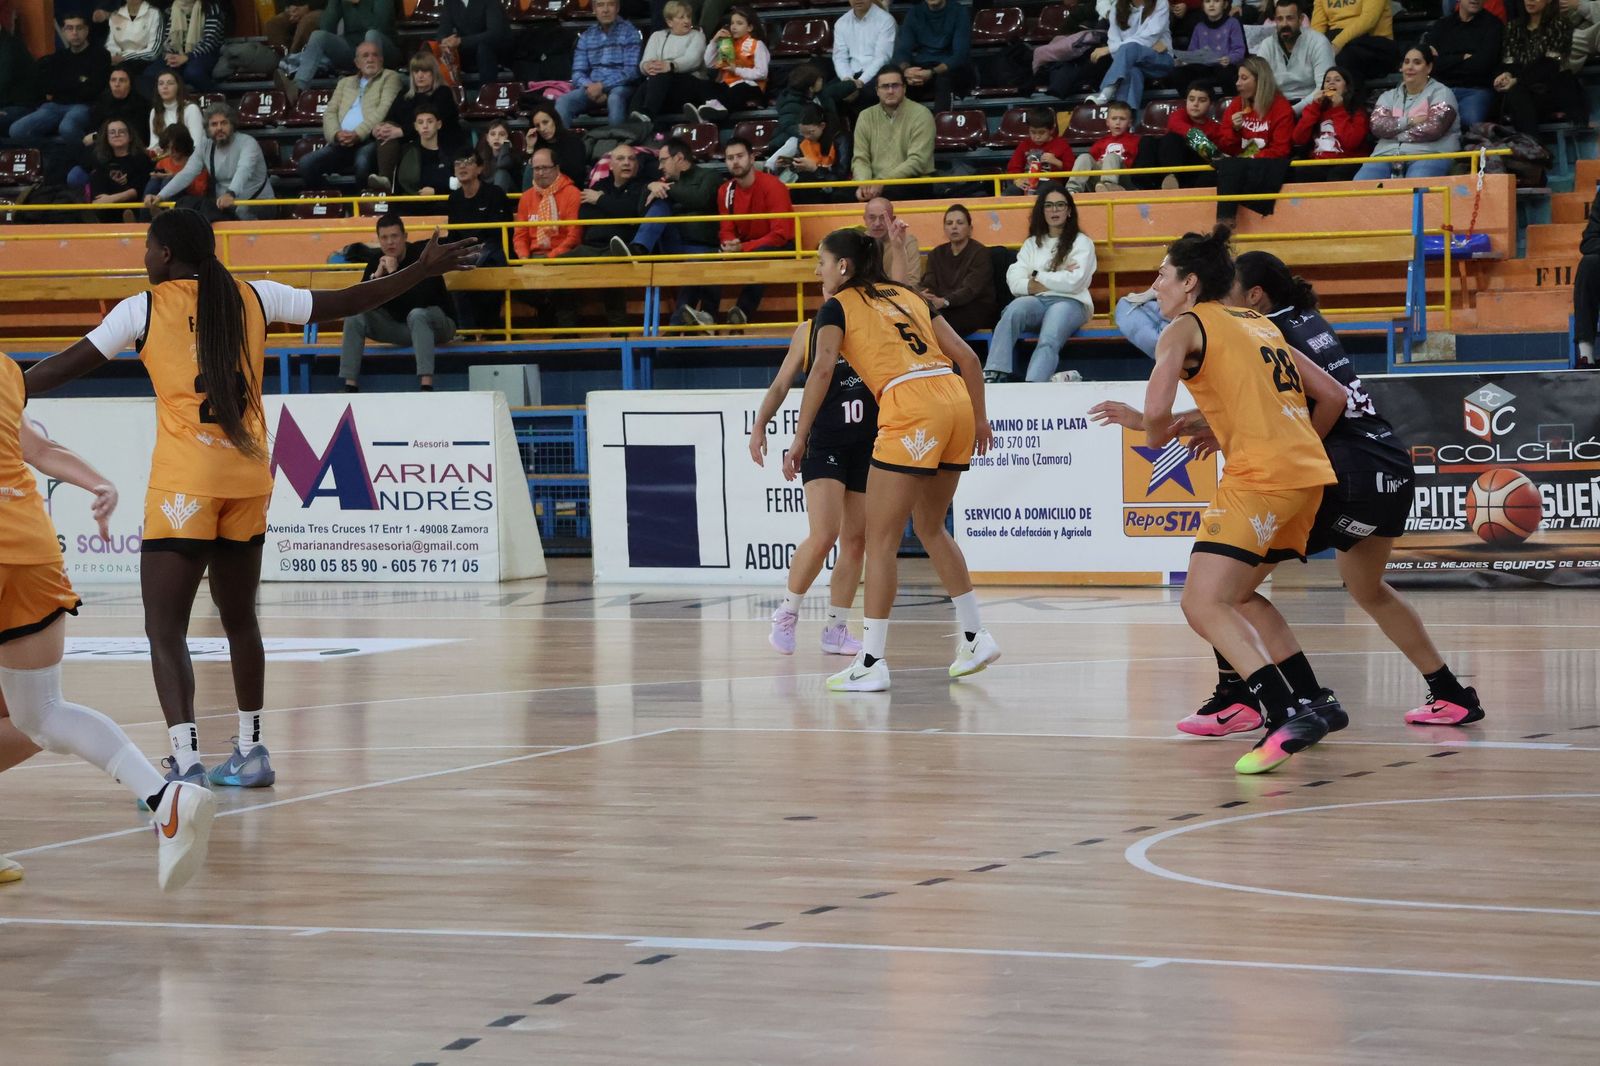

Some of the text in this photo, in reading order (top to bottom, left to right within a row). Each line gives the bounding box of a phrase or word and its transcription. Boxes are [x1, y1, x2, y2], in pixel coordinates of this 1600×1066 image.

[995, 13, 1004, 26] 7
[804, 23, 811, 35] 1
[498, 86, 507, 98] 8
[956, 114, 966, 127] 9
[690, 129, 697, 141] 1
[895, 322, 928, 356] 5
[1260, 346, 1302, 393] 28
[841, 399, 864, 424] 10
[990, 417, 1088, 432] AMINO DE LA PLATA
[413, 440, 449, 448] Asesoria
[993, 436, 1004, 448] 80
[1007, 435, 1022, 448] 570
[1025, 435, 1041, 448] 021
[1409, 436, 1600, 463] RCOLCHÓ
[970, 452, 1072, 467] orales del Vino (Zamora)
[766, 487, 808, 513] FERR
[964, 507, 1092, 520] SERVICIO A DOMICILIO DE
[1125, 511, 1201, 532] RepoSTA
[266, 524, 305, 534] Avenida
[308, 524, 329, 534] Tres
[331, 524, 366, 534] Cruces
[368, 524, 380, 534] 17
[382, 524, 403, 534] Entr
[405, 524, 411, 534] 1
[419, 524, 448, 534] 49008
[451, 524, 489, 534] Zamora
[966, 526, 1092, 540] Gasóleo de Calefacción y Agrícola
[292, 540, 479, 553] marianandresasesoria@gmail.com
[74, 563, 140, 573] PERSONAS
[292, 558, 316, 572] 980
[320, 559, 337, 572] 05
[341, 559, 358, 572] 85
[361, 559, 378, 572] 90
[391, 559, 417, 573] 605
[420, 559, 437, 573] 76
[441, 559, 457, 572] 71
[462, 559, 479, 573] 05
[1416, 561, 1438, 569] LOS
[1440, 561, 1490, 569] MEJORES
[1493, 560, 1556, 570] EQUIPOS
[1558, 560, 1574, 568] DE
[1576, 560, 1600, 568] DES
